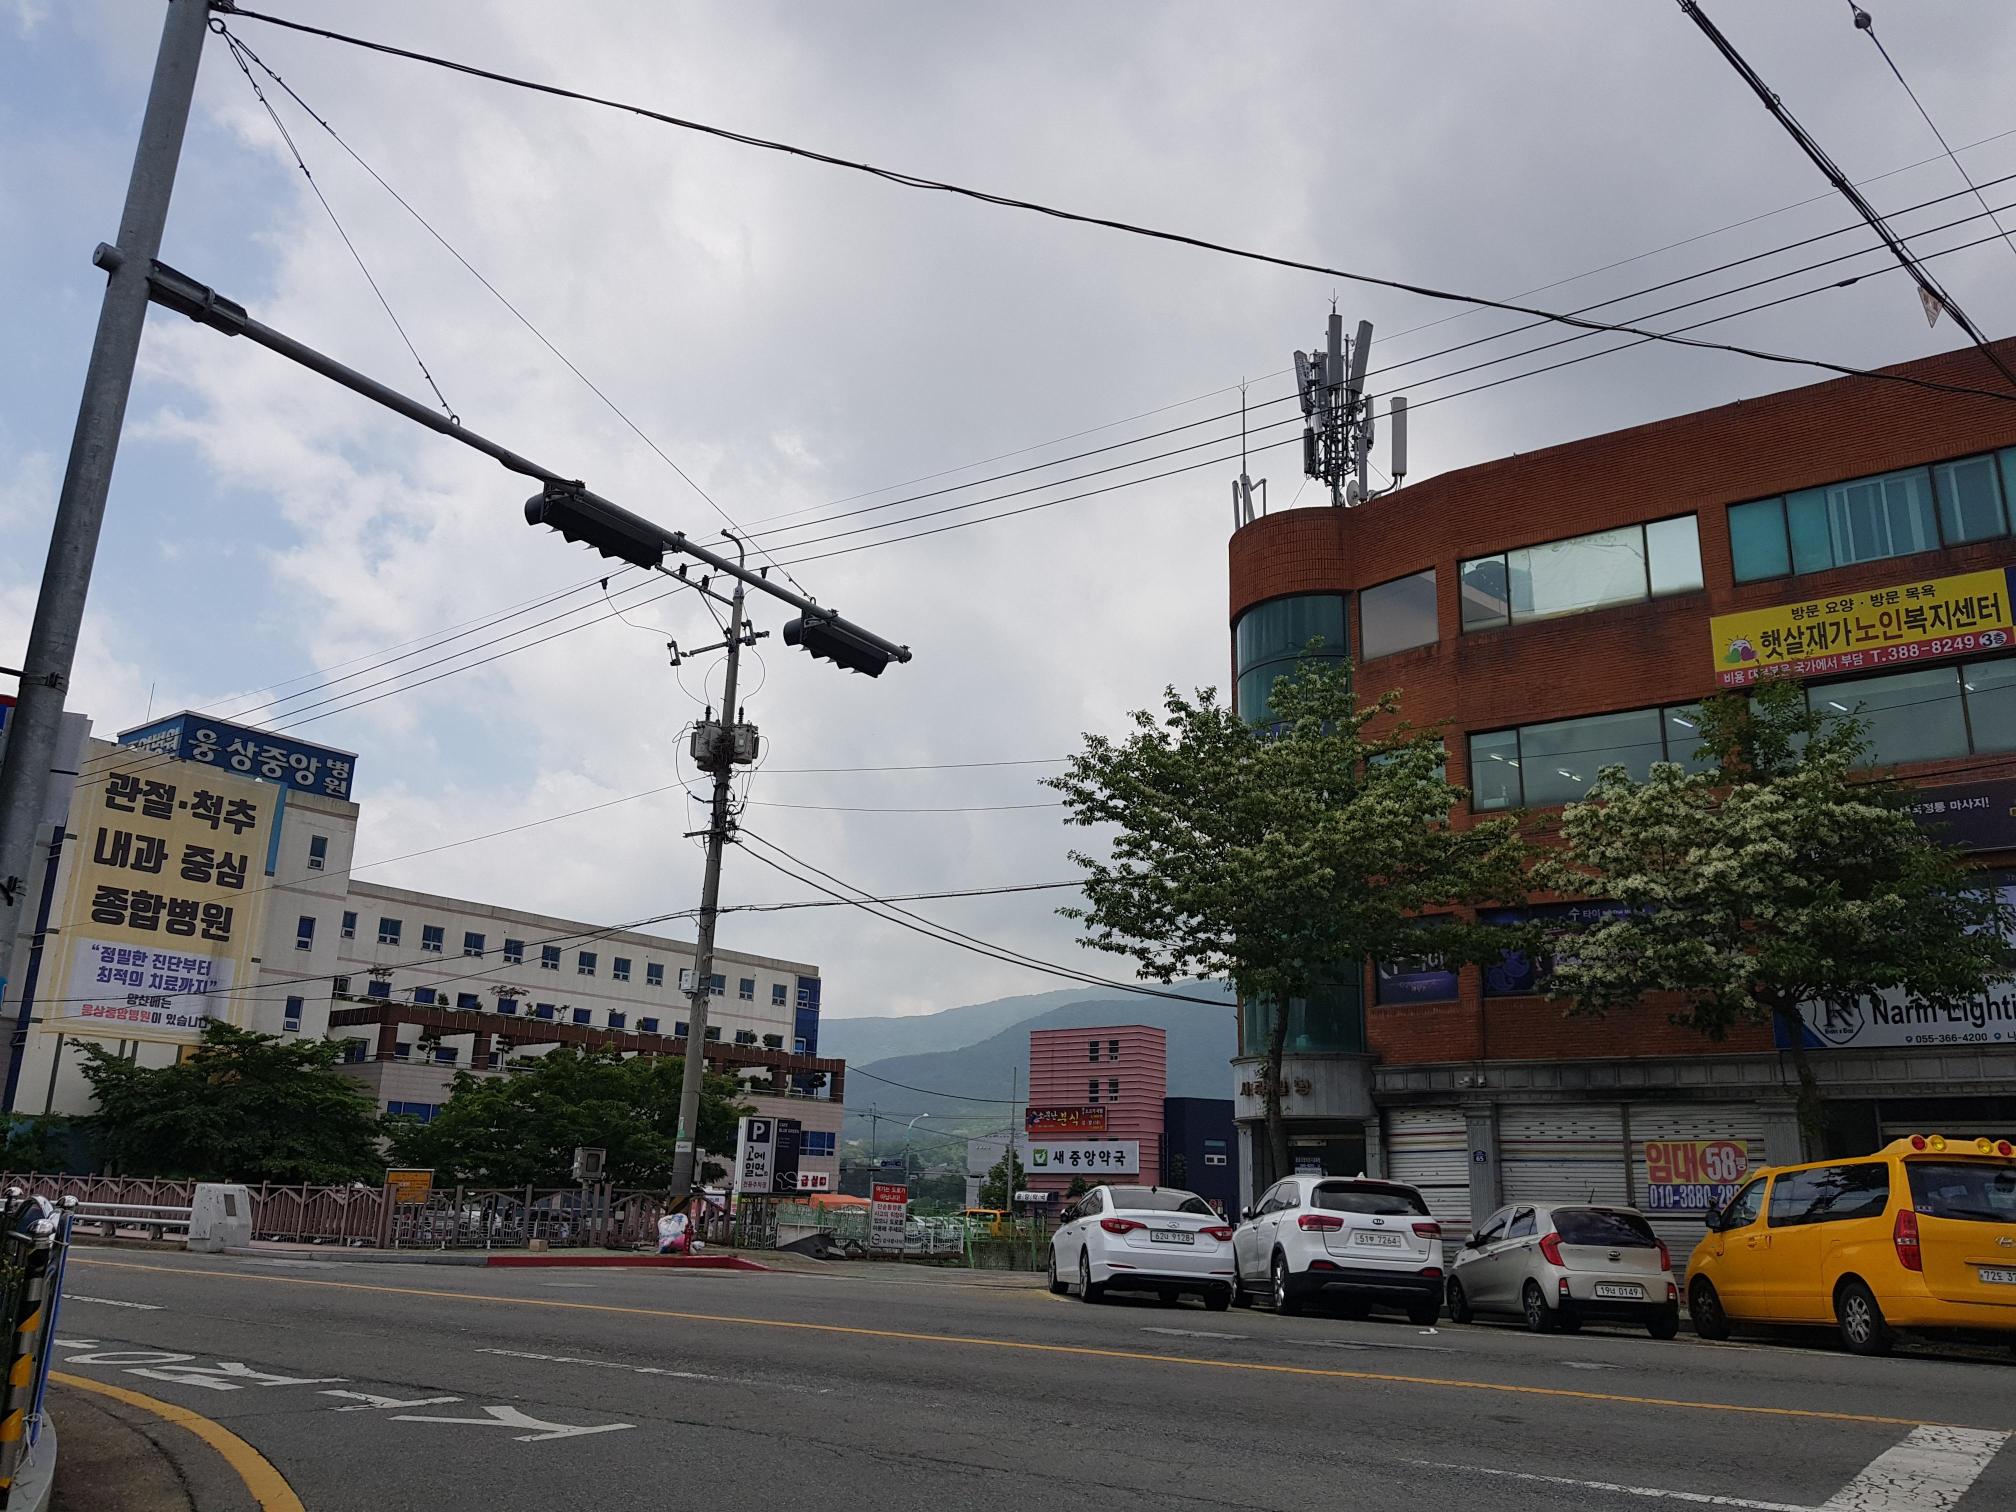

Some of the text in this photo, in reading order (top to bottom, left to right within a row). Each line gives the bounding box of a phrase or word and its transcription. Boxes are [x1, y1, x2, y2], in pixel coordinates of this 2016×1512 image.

[1791, 584, 1936, 621] 방문 요양 방문 목욕
[1723, 671, 1745, 685] 비용
[1794, 657, 1838, 673] 국가에서
[1841, 653, 1863, 668] 부담
[1870, 635, 1975, 663] T.388-8249
[188, 728, 350, 798] 웅상중앙 병원
[104, 772, 258, 836] 관절·척추
[1950, 797, 1990, 811] 마사지!
[93, 827, 248, 890] 내과 중심
[91, 884, 234, 943] 종합병원
[96, 965, 144, 988] 최적의
[151, 953, 212, 977] 진단부터
[1915, 1032, 1988, 1044] 055-366-4200
[752, 1122, 766, 1140] P
[1646, 1143, 1700, 1184] 임대
[1618, 1287, 1639, 1296] 0149
